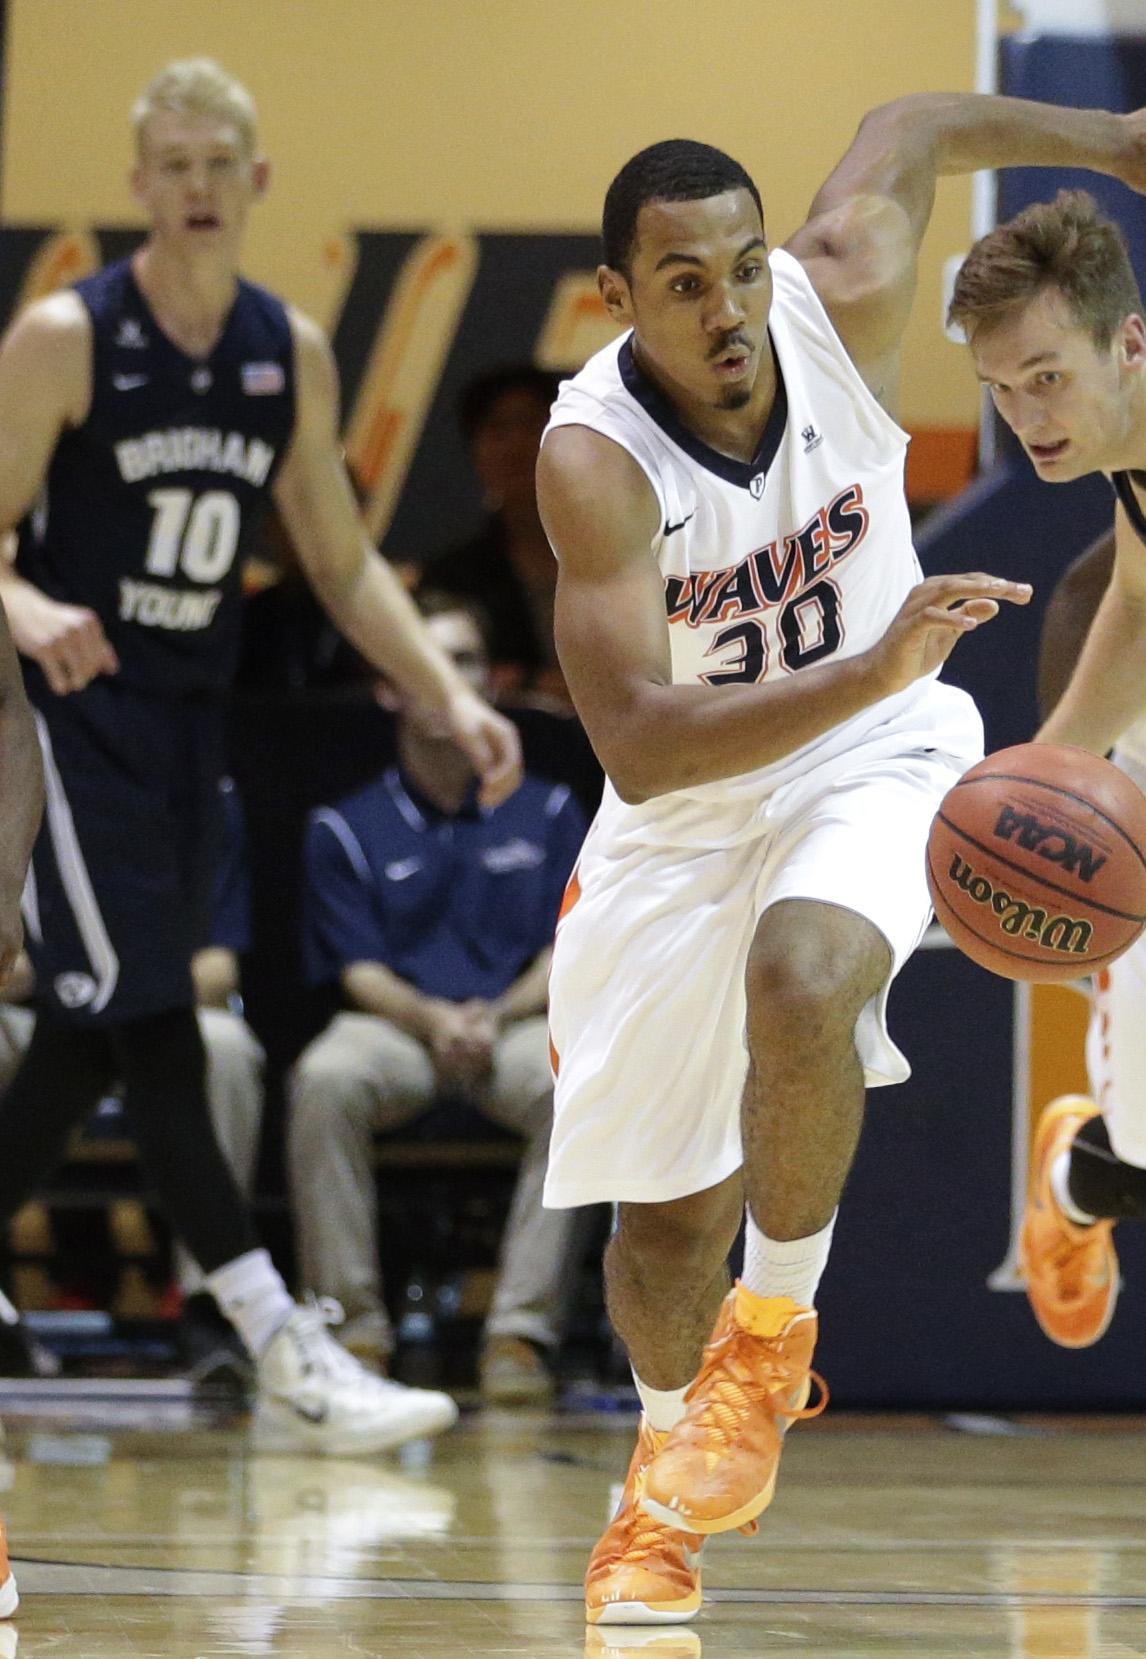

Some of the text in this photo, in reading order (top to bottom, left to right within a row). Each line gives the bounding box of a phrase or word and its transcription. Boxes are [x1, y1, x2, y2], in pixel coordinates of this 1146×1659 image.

[145, 487, 242, 583] 10
[665, 483, 870, 628] WAVES
[697, 576, 843, 687] 30
[993, 804, 1107, 883] NCAA
[949, 852, 1094, 954] Wilson
